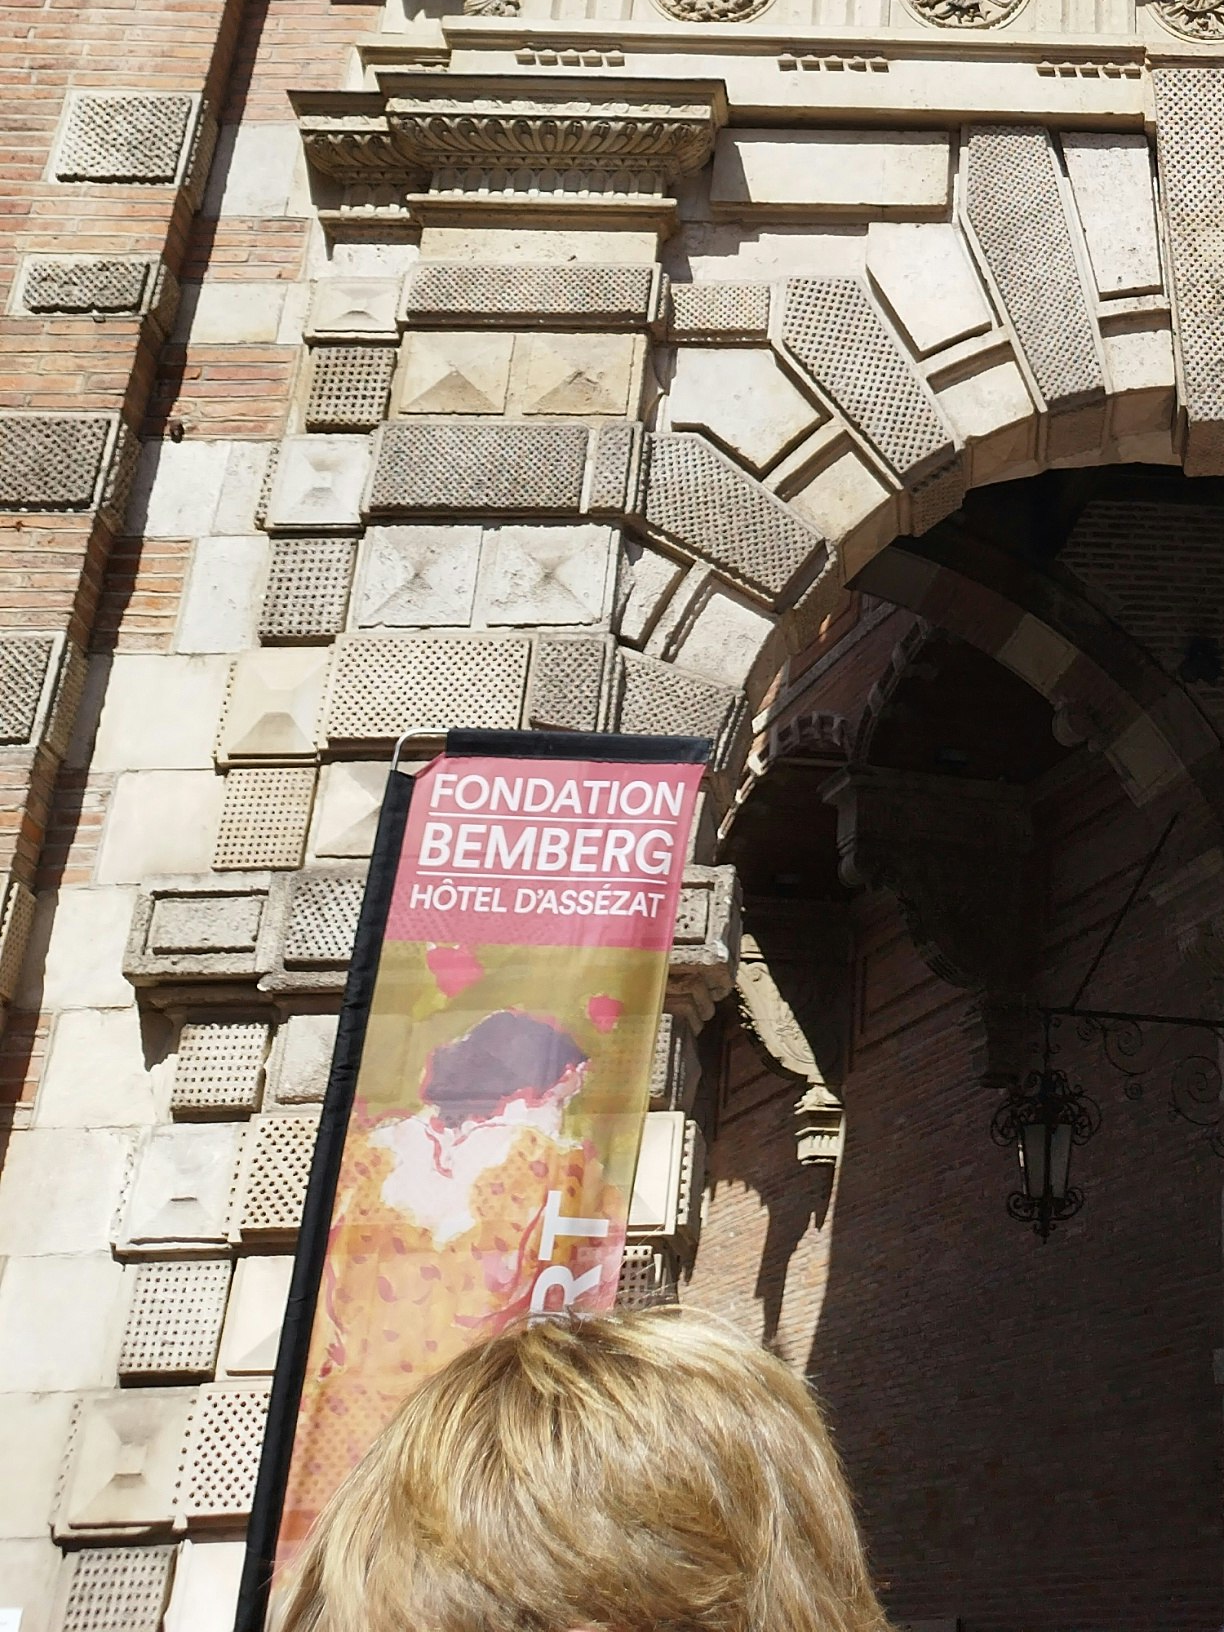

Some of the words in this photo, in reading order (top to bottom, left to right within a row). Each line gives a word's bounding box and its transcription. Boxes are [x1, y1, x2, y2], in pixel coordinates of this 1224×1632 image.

[429, 773, 685, 817] FONDATION
[417, 822, 674, 875] BEMBERG
[409, 878, 508, 913] HÔTEL
